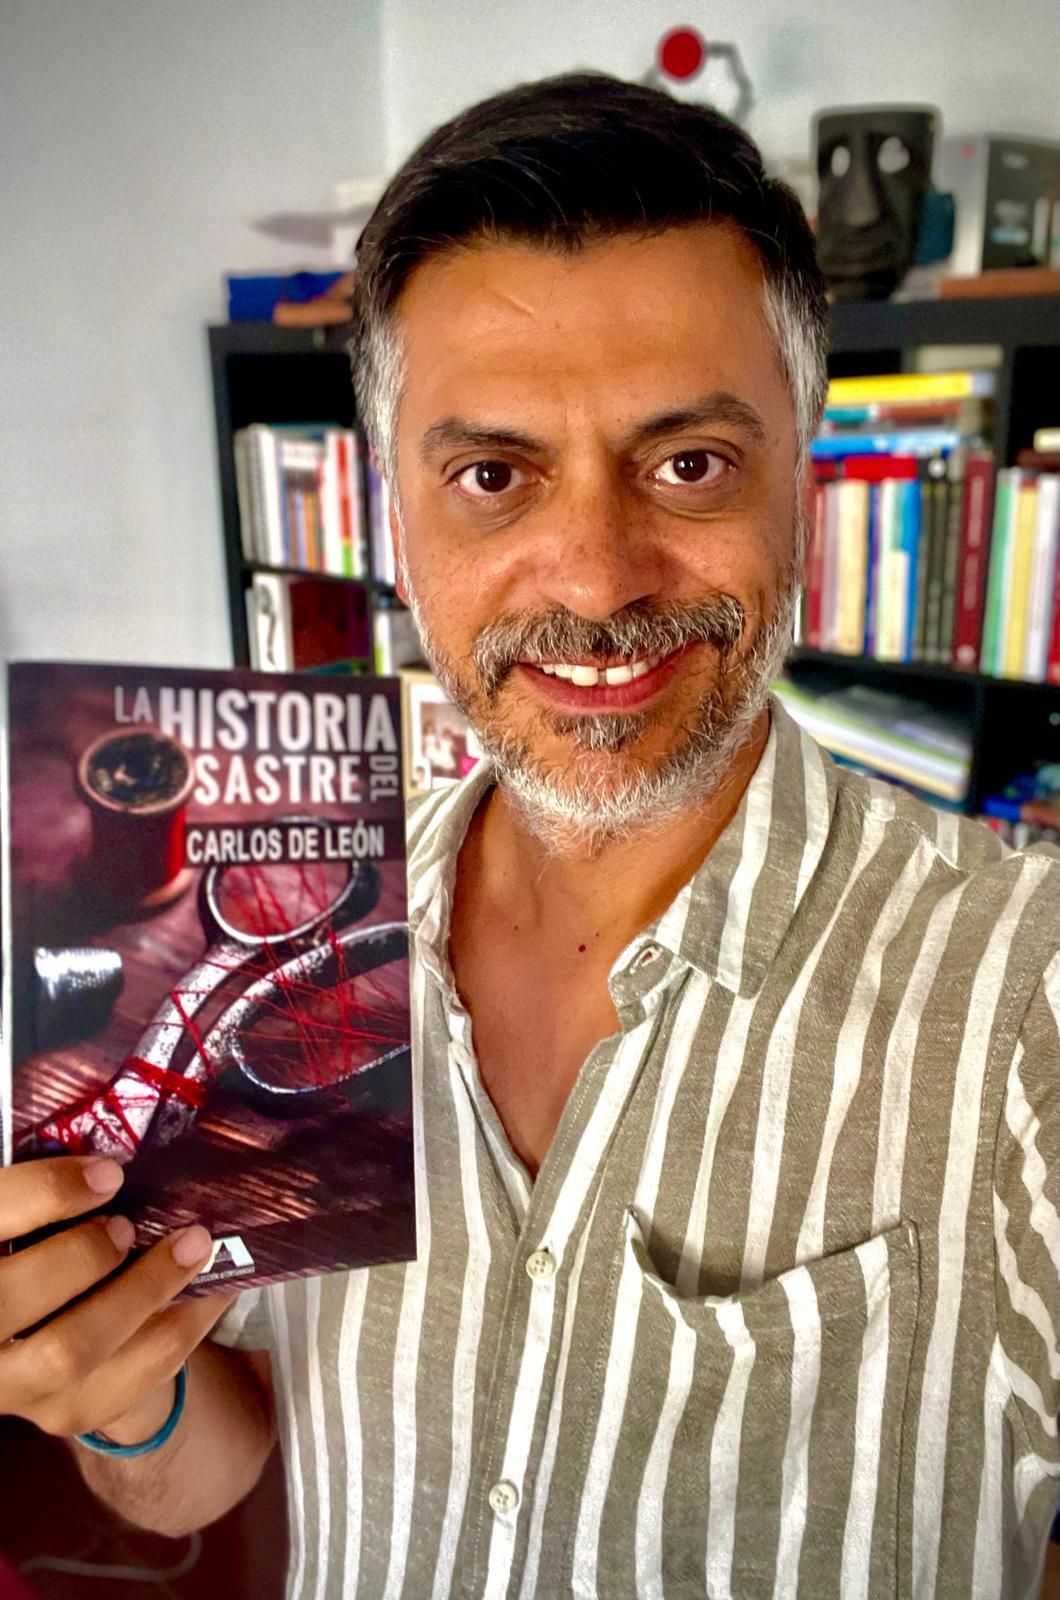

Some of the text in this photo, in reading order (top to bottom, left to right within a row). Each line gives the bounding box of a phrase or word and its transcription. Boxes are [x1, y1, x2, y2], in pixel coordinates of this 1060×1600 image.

[115, 687, 397, 752] LA HISTORIA
[195, 756, 362, 804] SASTRE
[370, 756, 398, 801] DEL
[187, 819, 384, 862] CARLOS DE LEÓN
